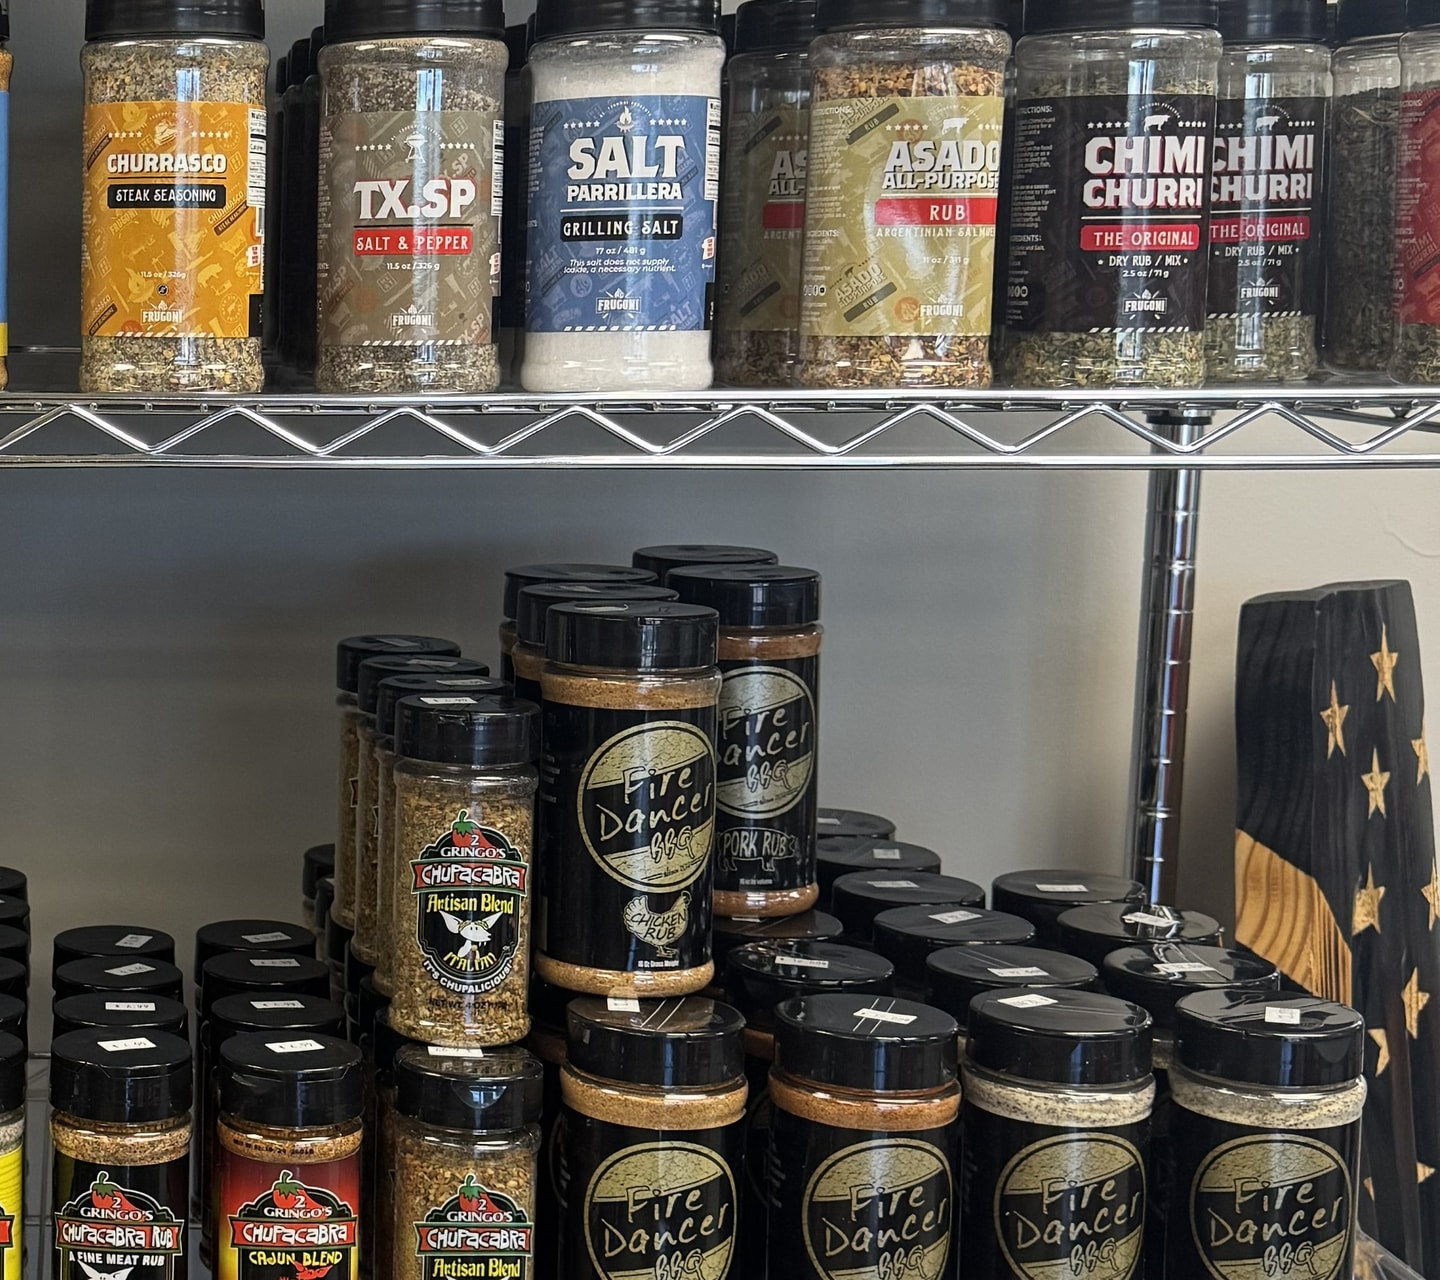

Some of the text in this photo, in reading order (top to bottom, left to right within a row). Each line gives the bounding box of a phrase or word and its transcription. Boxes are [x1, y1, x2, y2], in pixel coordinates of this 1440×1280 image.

[107, 152, 228, 174] CHURRASCO
[566, 134, 686, 181] SALT
[115, 187, 217, 203] STEAK SEASONING
[353, 178, 477, 220] TX.SP
[566, 181, 683, 203] PARRILLERA
[929, 204, 966, 221] RUB
[562, 218, 679, 237] GRILLING SALT
[356, 234, 469, 252] SALT & PEPPER
[1093, 231, 1195, 247] THE ORIGINAL
[1108, 255, 1182, 268] DRY RUB MIX
[142, 309, 184, 324] FRUGONI
[622, 766, 694, 806] Fire
[595, 783, 712, 842] Dancer
[649, 824, 701, 864] BBQ
[722, 830, 787, 858] PORK RUB
[427, 893, 514, 915] Artisan Blend
[629, 910, 688, 928] CHICKEN
[644, 923, 676, 940] RUB
[77, 1251, 166, 1267] FINE MEAT RUB
[248, 1250, 344, 1267] CAJUN BLEND
